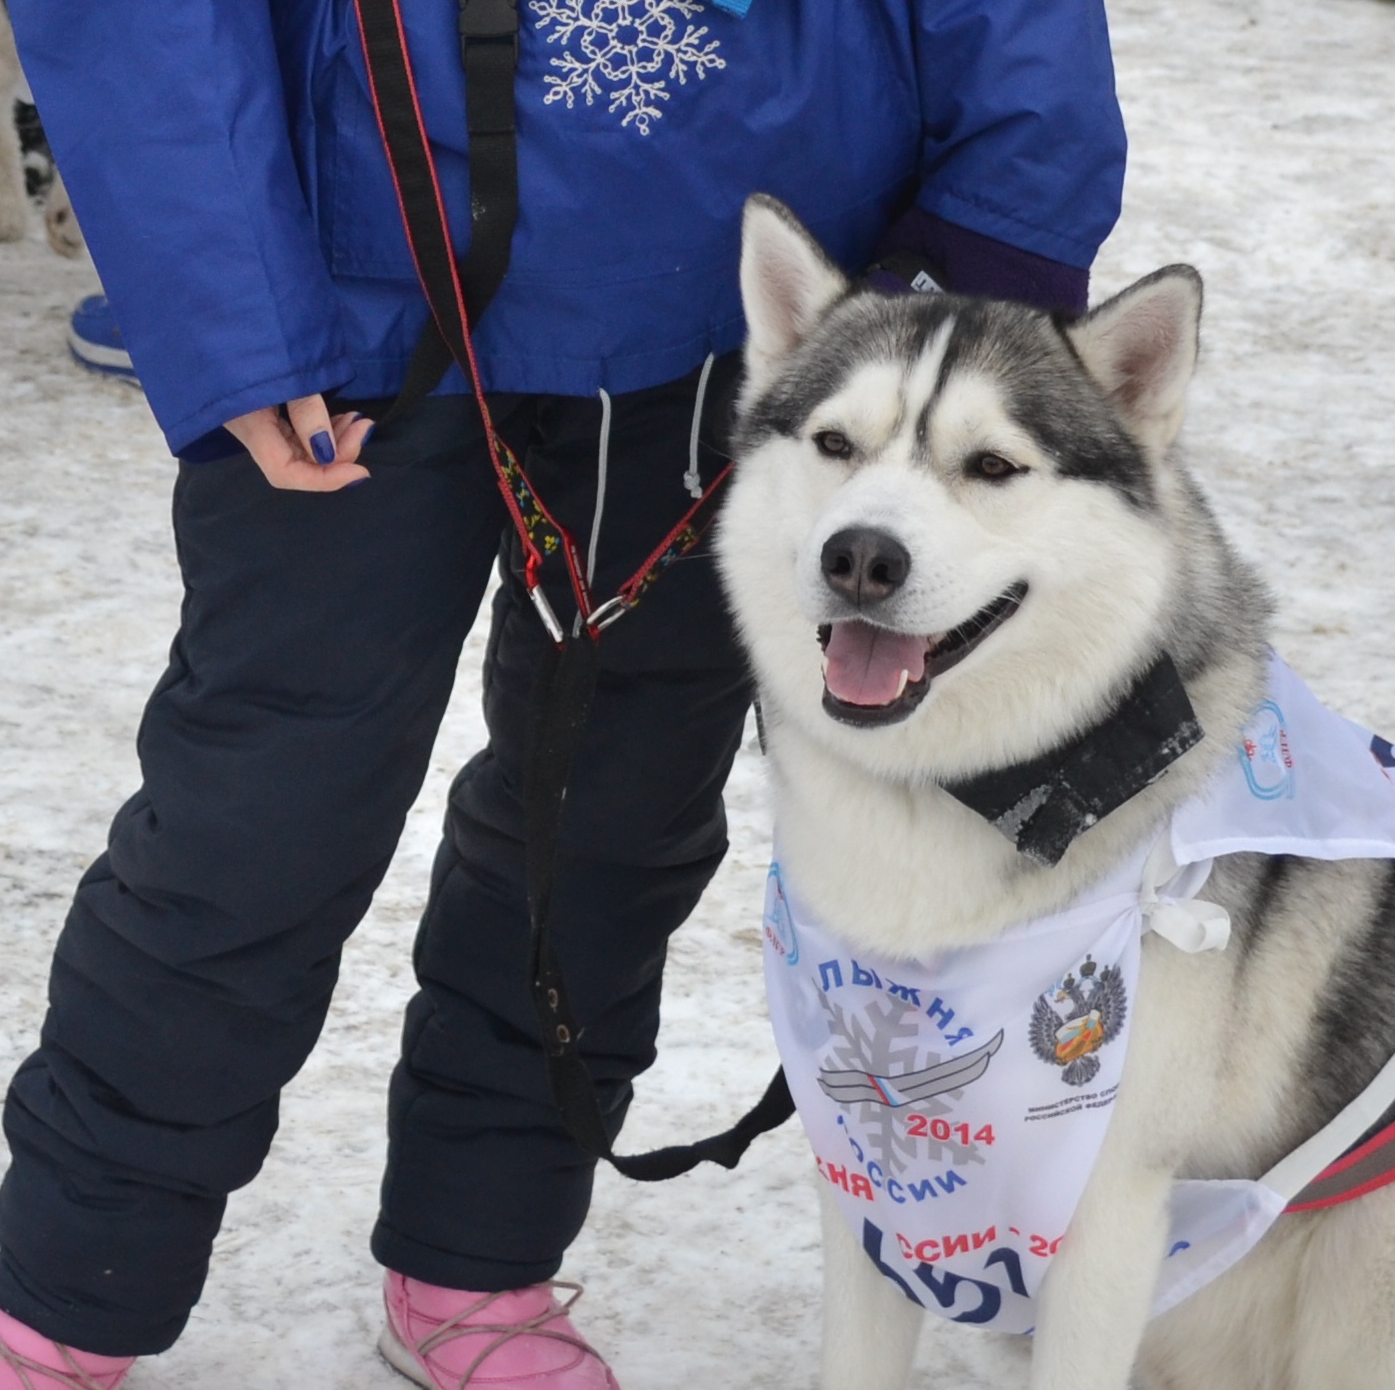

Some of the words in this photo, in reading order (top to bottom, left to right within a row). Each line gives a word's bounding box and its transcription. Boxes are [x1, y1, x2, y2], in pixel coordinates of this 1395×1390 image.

[818, 959, 974, 1046] ЛЫЖНЯ
[1024, 1104, 1083, 1122] РОССИЙСКОЙ
[1028, 1093, 1098, 1113] МИНИСТЕРСТВО
[907, 1113, 996, 1146] 2014
